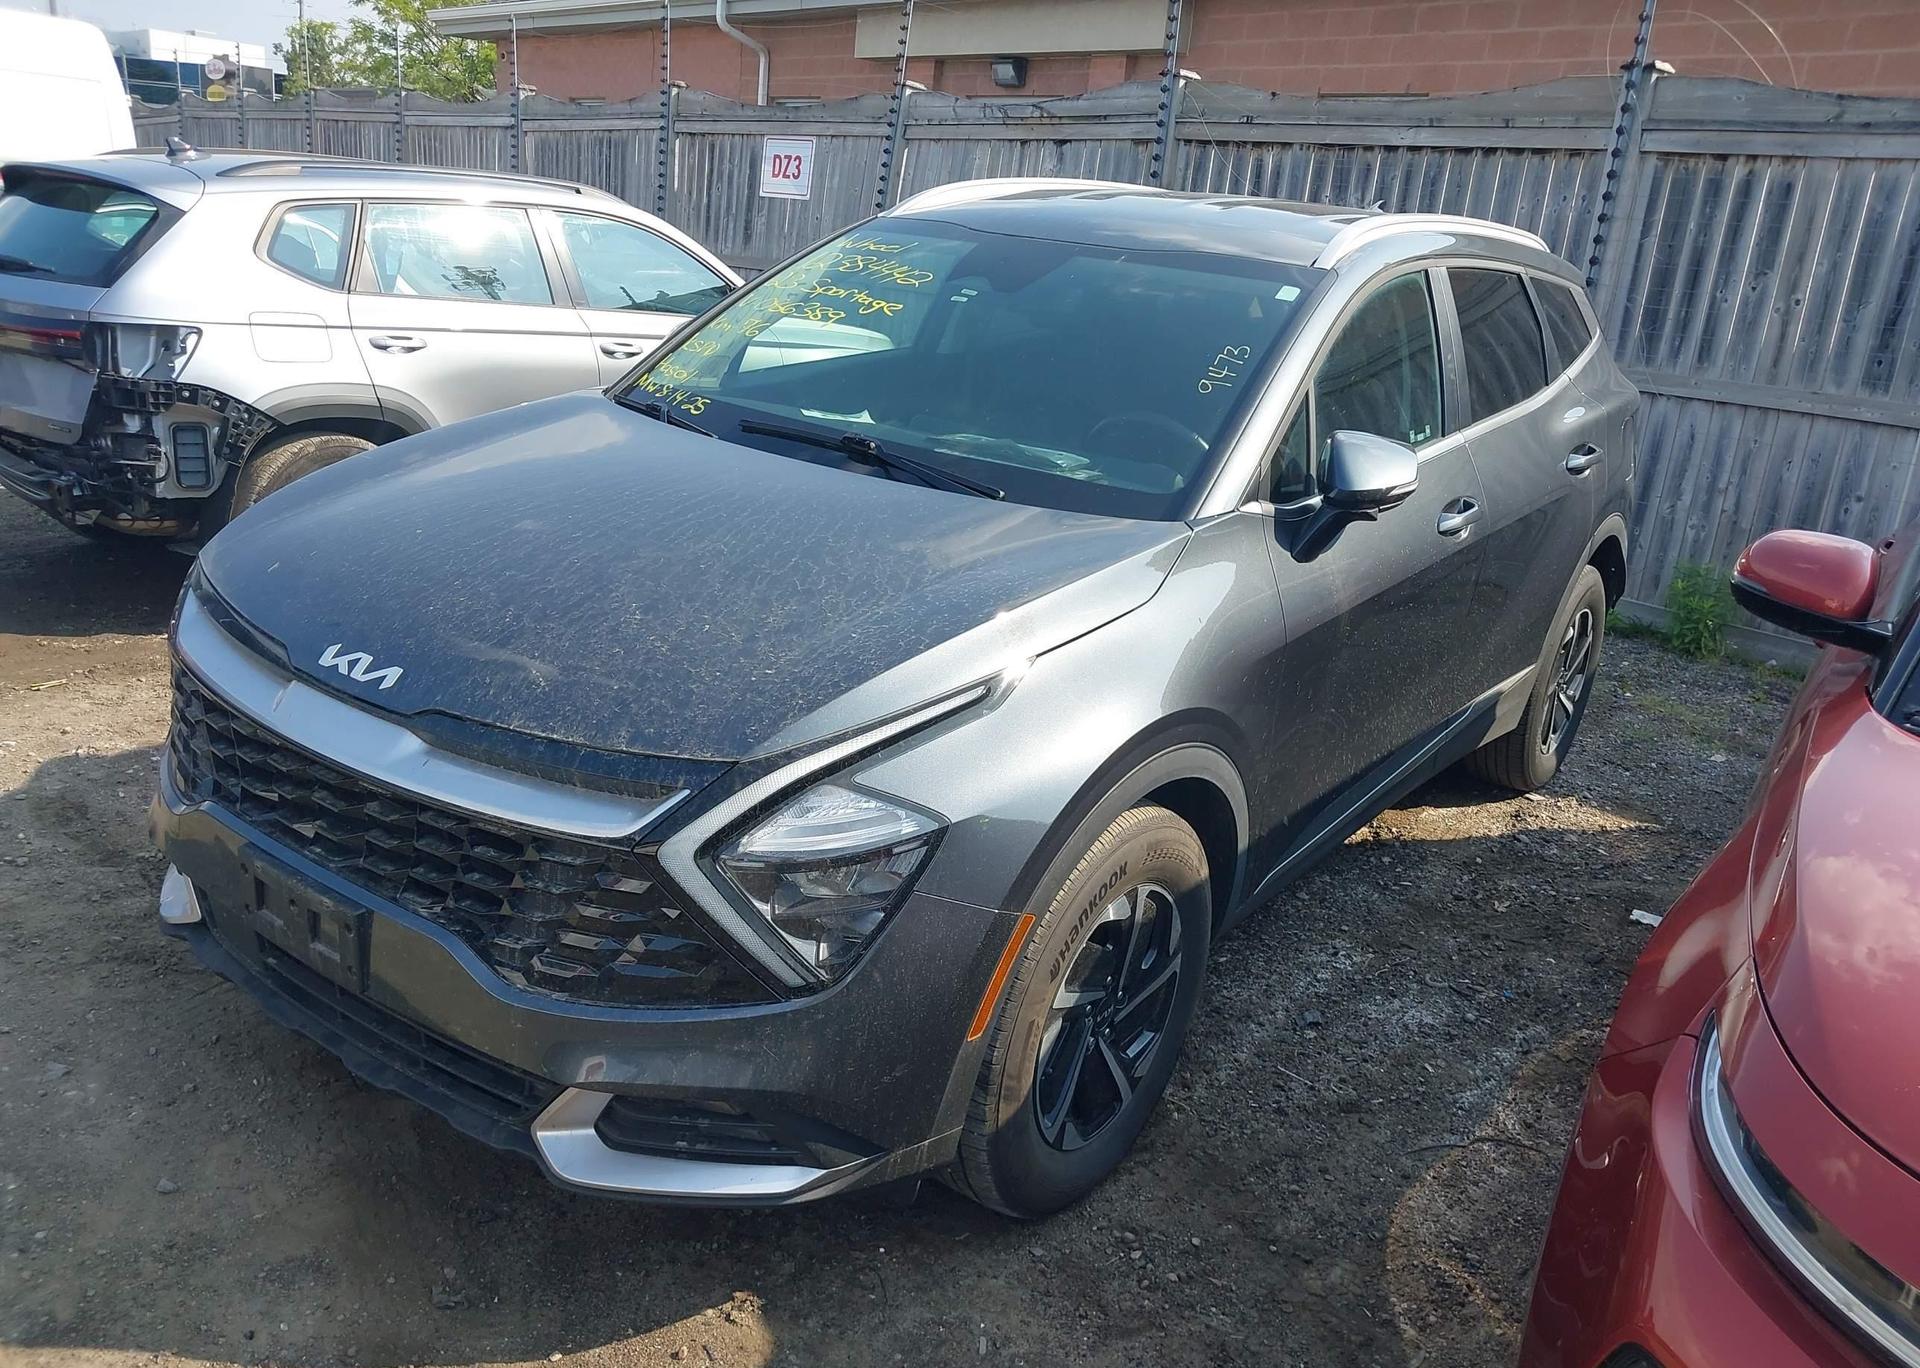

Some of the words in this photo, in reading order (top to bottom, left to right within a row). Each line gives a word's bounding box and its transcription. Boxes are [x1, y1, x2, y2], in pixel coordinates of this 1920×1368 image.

[771, 153, 803, 180] DZ3
[800, 279, 904, 317] Sportage
[1198, 345, 1251, 393] 9473
[318, 643, 404, 690] KIA
